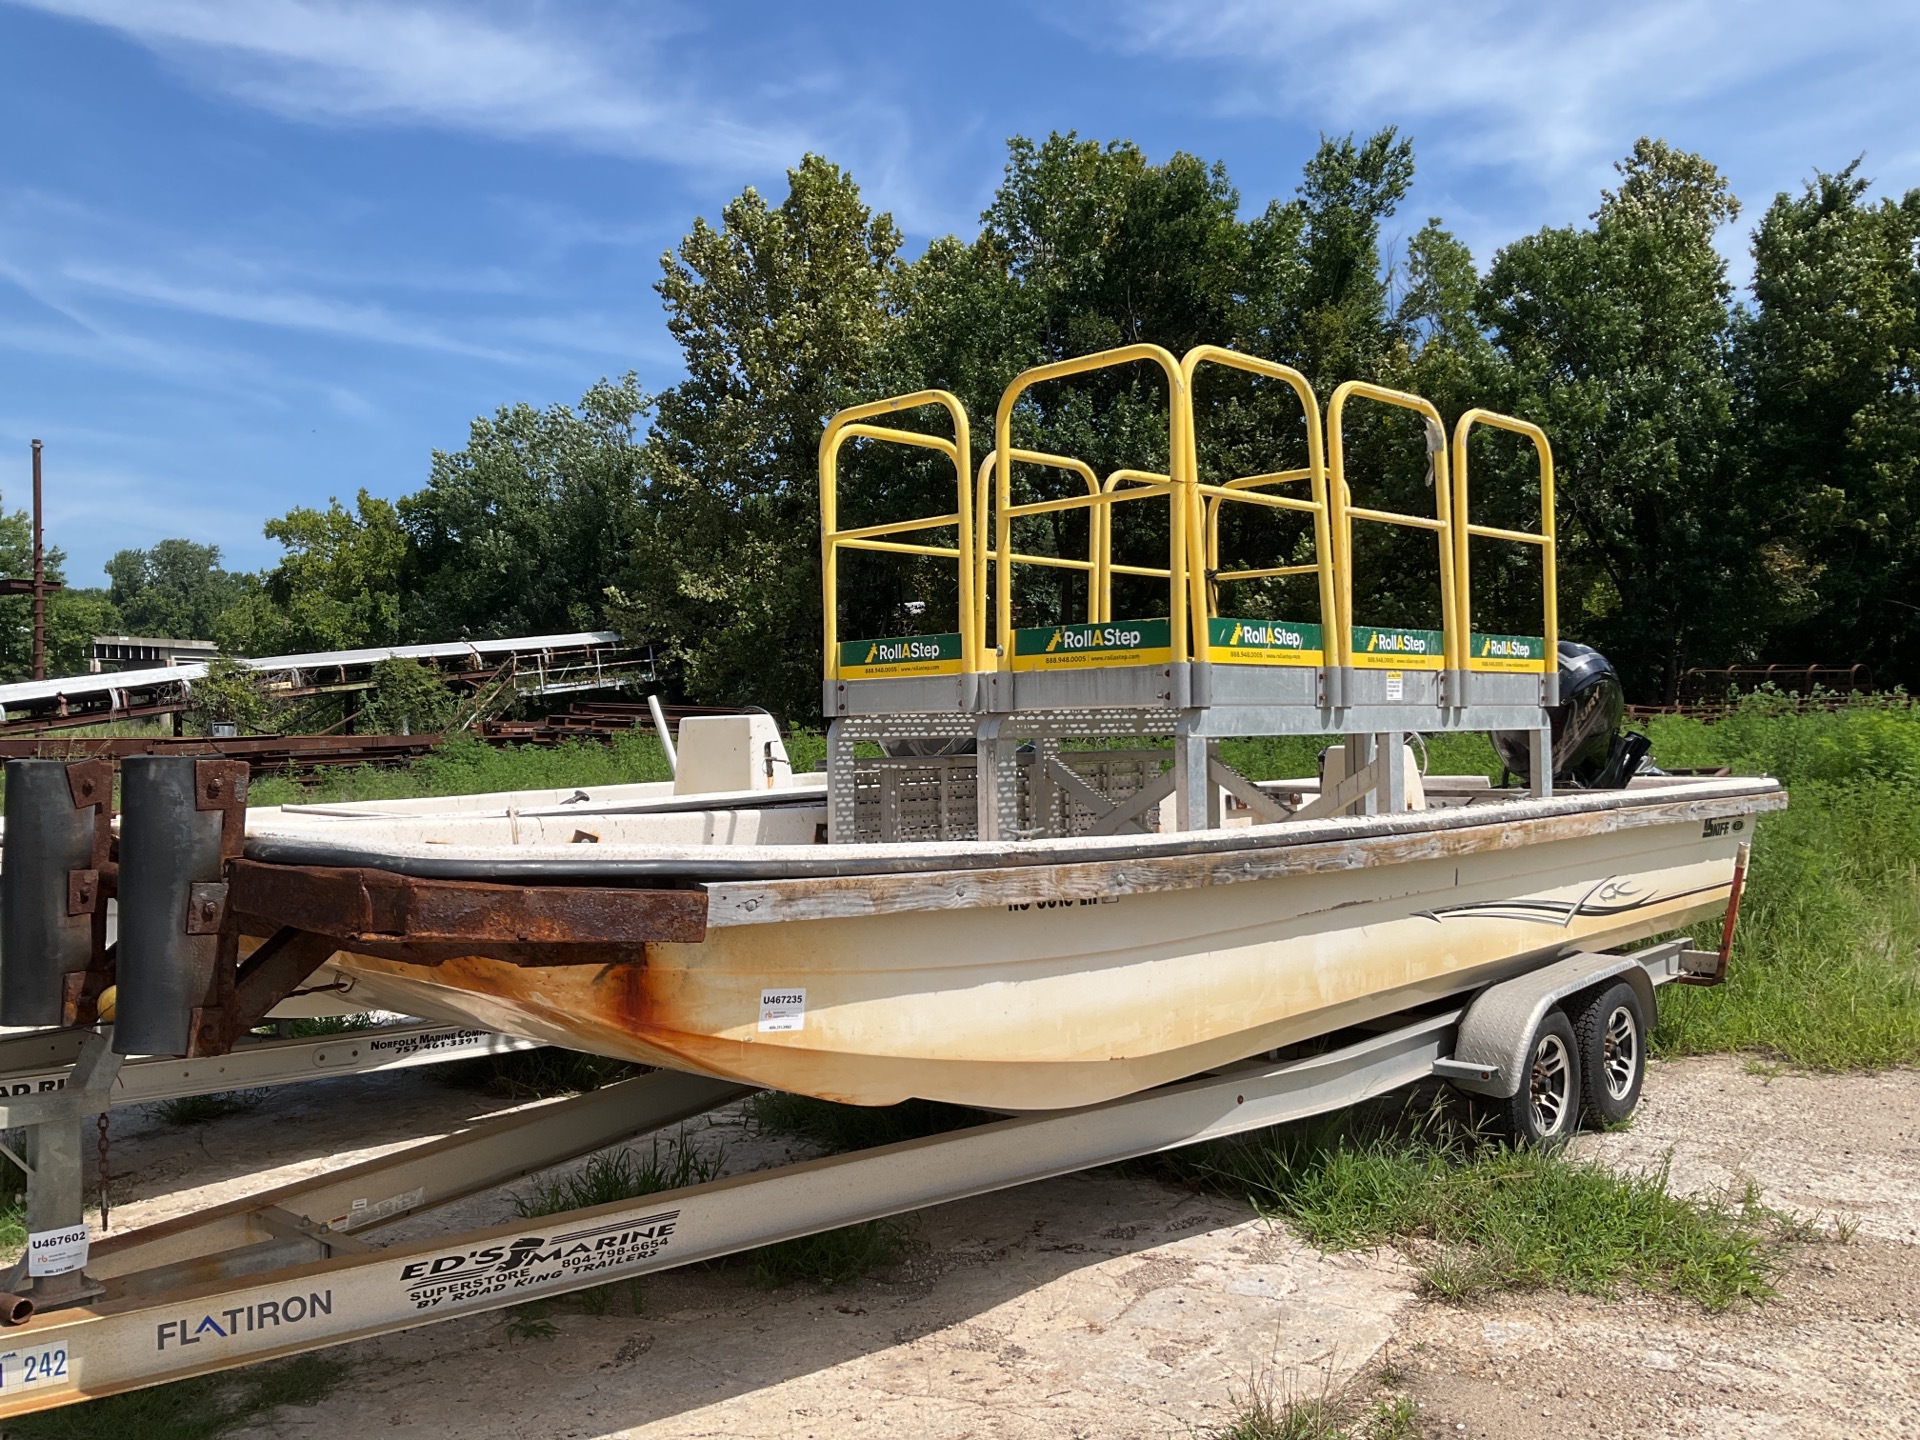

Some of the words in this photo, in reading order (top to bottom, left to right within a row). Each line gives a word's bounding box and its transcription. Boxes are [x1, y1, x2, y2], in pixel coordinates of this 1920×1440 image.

[1064, 628, 1141, 648] RollAStep
[1244, 626, 1300, 648] RollAStep
[1379, 634, 1426, 653] RollAStep
[879, 642, 940, 659] RollAStep
[1045, 655, 1087, 664] 888.948.0005
[1090, 653, 1140, 662] www.rollastep.com
[1491, 640, 1530, 658] RollAStep
[763, 995, 803, 1005] U467235
[370, 1037, 417, 1051] NORFOLK
[419, 1032, 456, 1045] MARINE
[395, 1036, 479, 1054] 757-461-3391
[32, 1231, 86, 1249] U467602
[400, 1246, 506, 1280] ED'S
[523, 1222, 676, 1266] MARINE
[410, 1268, 530, 1301] SUPERSTORE
[561, 1237, 669, 1268] 804-798-6654
[416, 1296, 444, 1309] BY
[450, 1283, 507, 1301] ROAD
[514, 1270, 563, 1288] KING
[572, 1248, 660, 1275] TRAILERS
[157, 1290, 332, 1351] FLATIRON
[24, 1349, 67, 1383] 242
